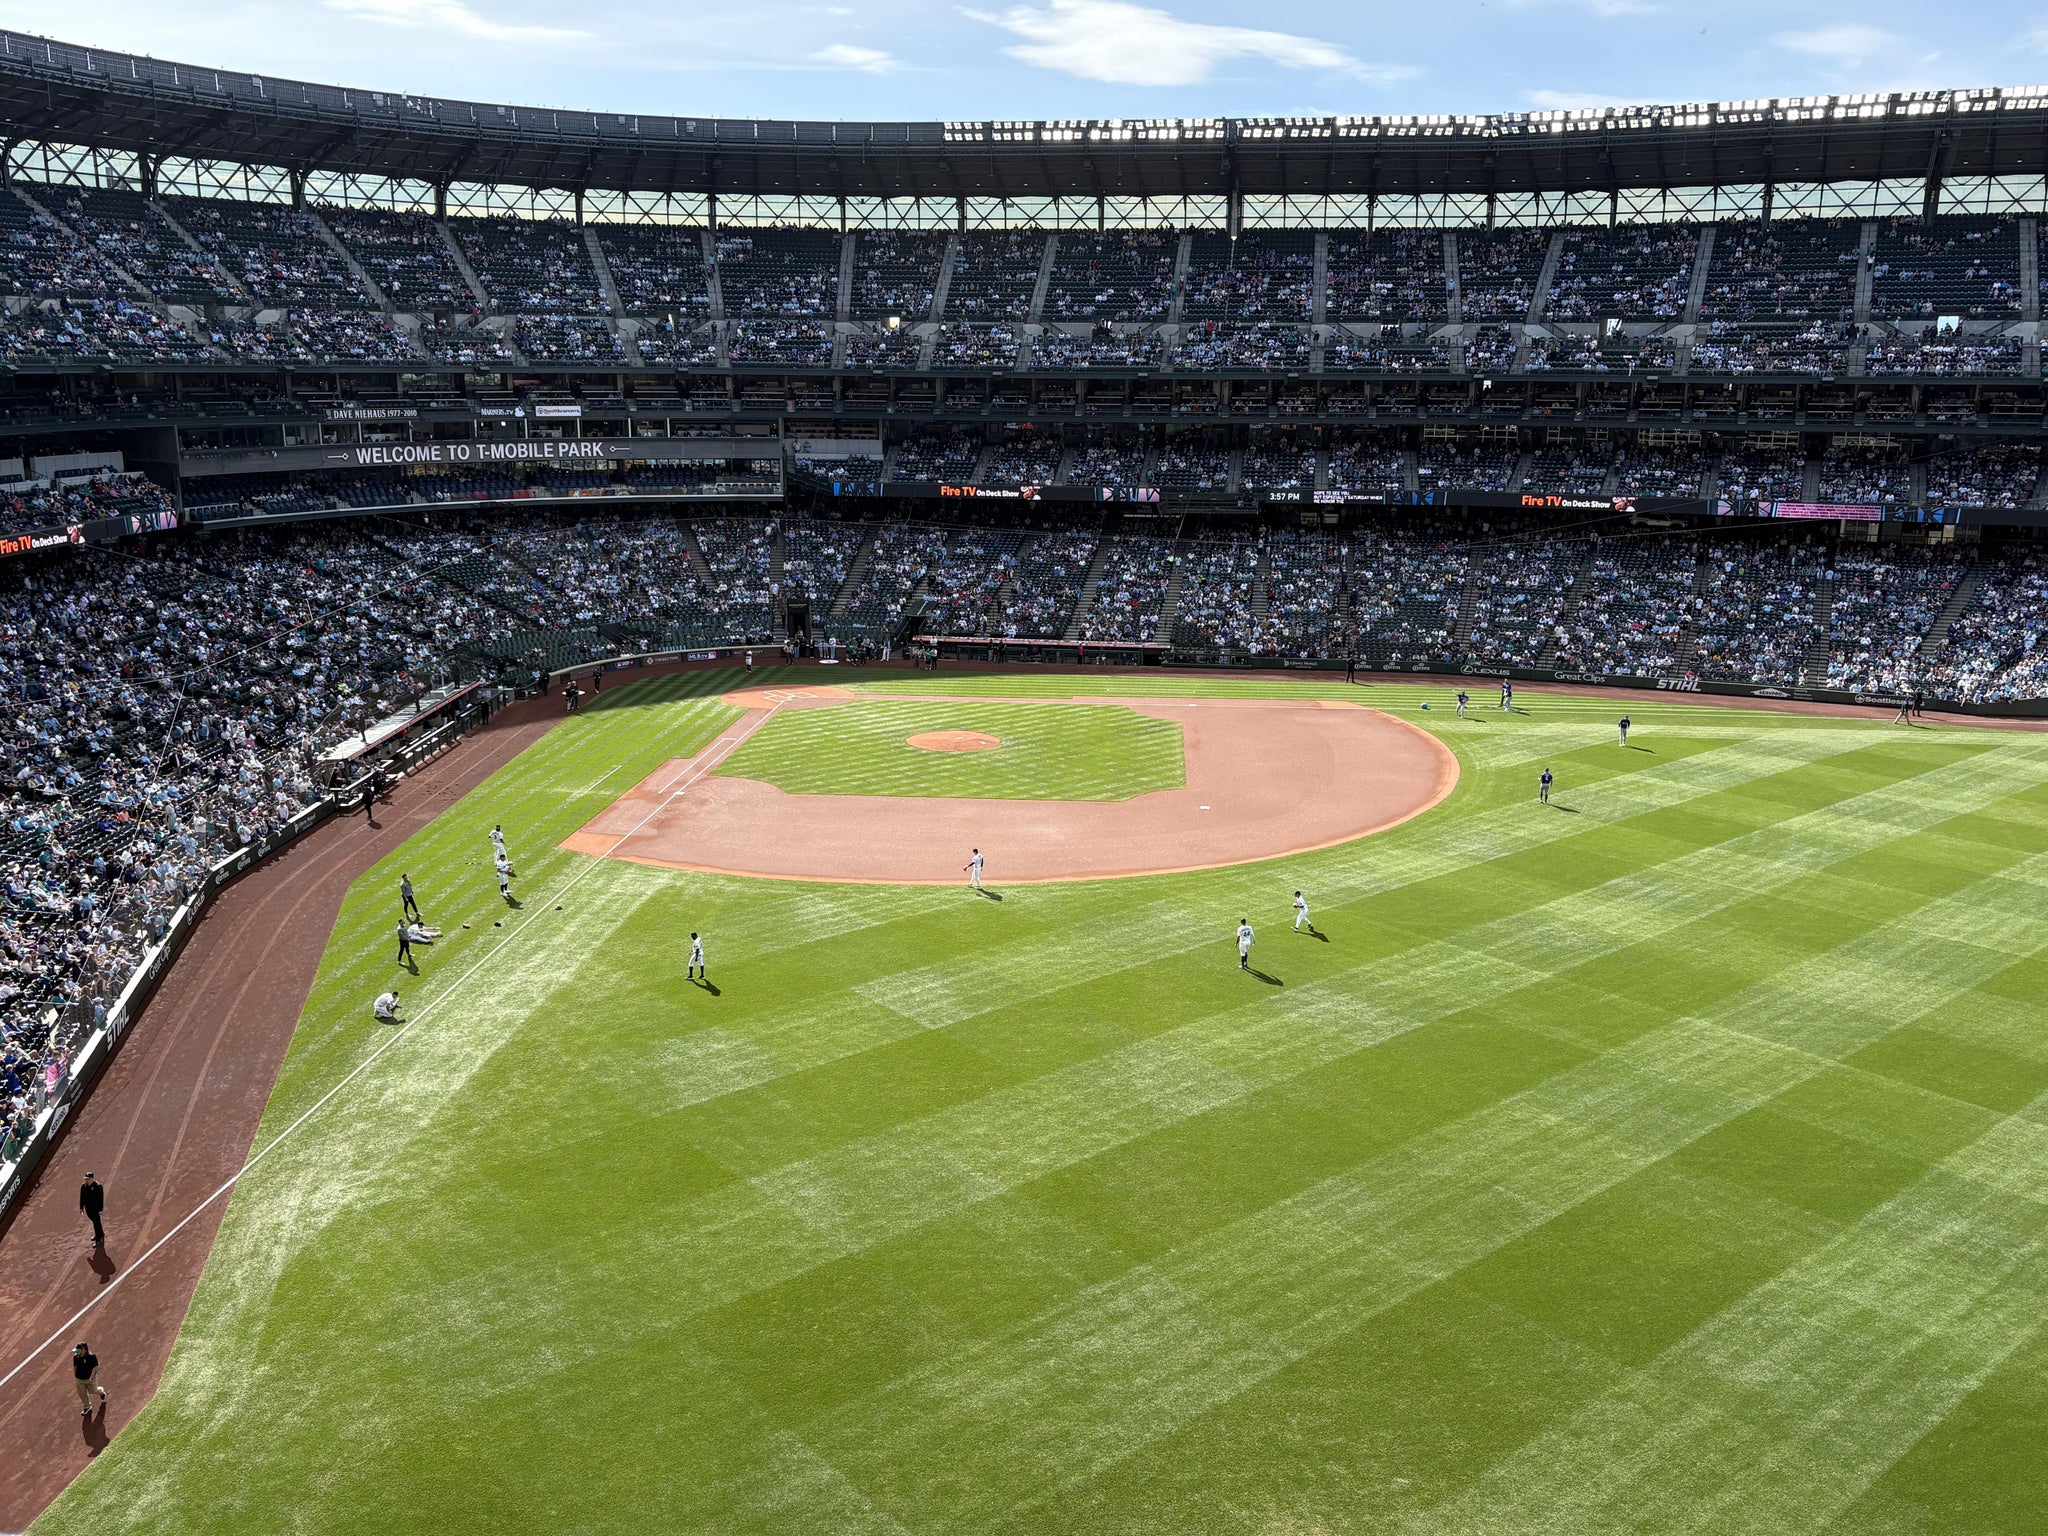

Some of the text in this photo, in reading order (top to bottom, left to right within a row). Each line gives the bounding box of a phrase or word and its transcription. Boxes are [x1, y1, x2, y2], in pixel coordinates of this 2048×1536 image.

[333, 409, 418, 419] DAVE NIEHAUS 1977-2010
[356, 442, 604, 464] WELCOME TO T-MOBILE PARK
[941, 486, 960, 496] Fire
[961, 486, 977, 496] TV
[1002, 490, 1019, 498] Show
[1522, 495, 1544, 507] Fire
[1546, 496, 1562, 507] TV
[1573, 500, 1590, 508] Deck
[0, 534, 67, 555] Fire TV On Deck Show
[1554, 671, 1605, 684] Great Clips
[1656, 680, 1701, 691] STIHL
[192, 891, 205, 915] LEXUS
[149, 941, 171, 980] Great Clips
[107, 1005, 130, 1051] STIHL
[51, 1107, 66, 1134] SERVPRO
[0, 1174, 21, 1214] SPORTS
